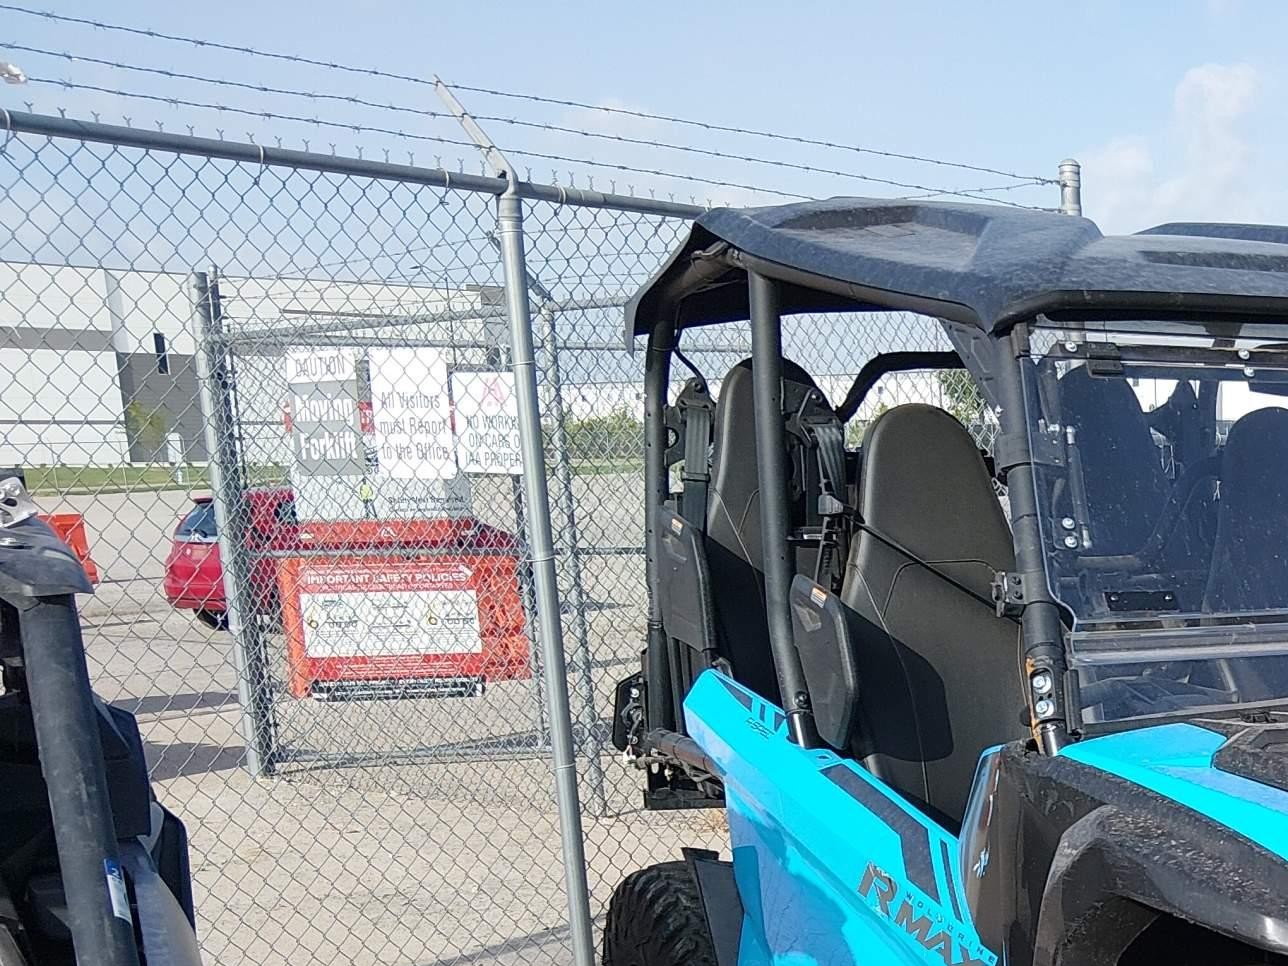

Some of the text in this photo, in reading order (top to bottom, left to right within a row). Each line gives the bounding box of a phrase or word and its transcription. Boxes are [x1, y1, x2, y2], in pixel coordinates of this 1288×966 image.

[296, 355, 345, 377] CAUTION
[295, 393, 354, 426] Moving
[381, 391, 441, 410] All Visitors
[380, 417, 447, 438] must Report
[467, 415, 480, 429] NO
[299, 431, 358, 460] Forklift
[382, 443, 391, 460] to
[396, 442, 412, 460] the
[416, 442, 450, 460] Office
[469, 433, 482, 448] ON
[485, 433, 511, 449] CARS
[307, 573, 467, 585] IMPORTANT SAFETY POLICIES
[906, 890, 995, 963] WOLVERINE
